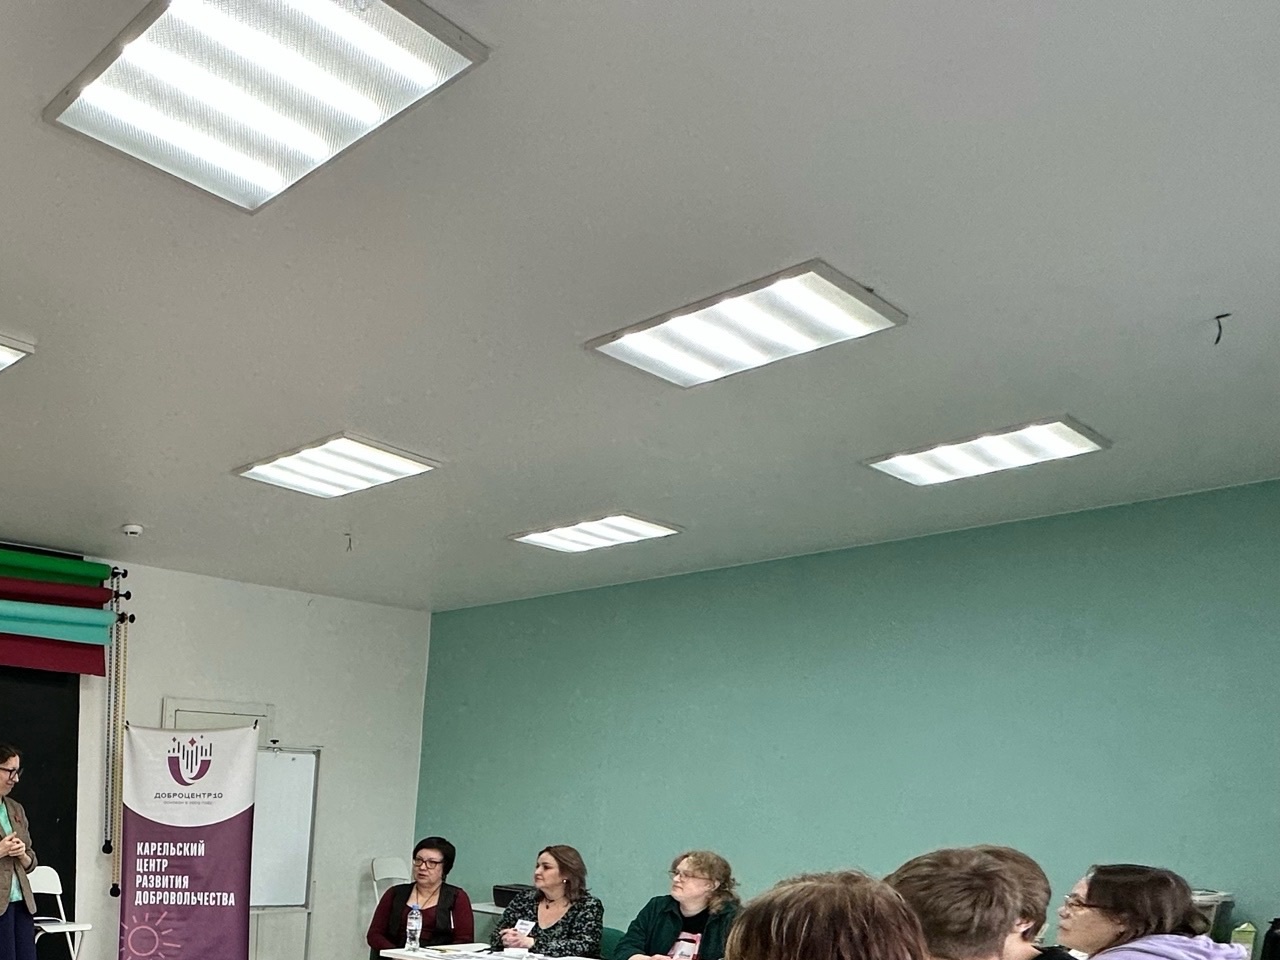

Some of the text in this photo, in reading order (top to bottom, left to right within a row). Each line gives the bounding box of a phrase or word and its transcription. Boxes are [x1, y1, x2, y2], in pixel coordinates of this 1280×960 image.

[154, 792, 224, 800] ДОБРОЦЕНТР10
[136, 840, 206, 857] КАРЕЛЬСКИЙ
[136, 858, 169, 873] ЦЕНТР
[135, 874, 189, 889] РАЗВИТИЯ
[134, 890, 236, 906] ДОБРОВОЛЬЧЕСТВА
